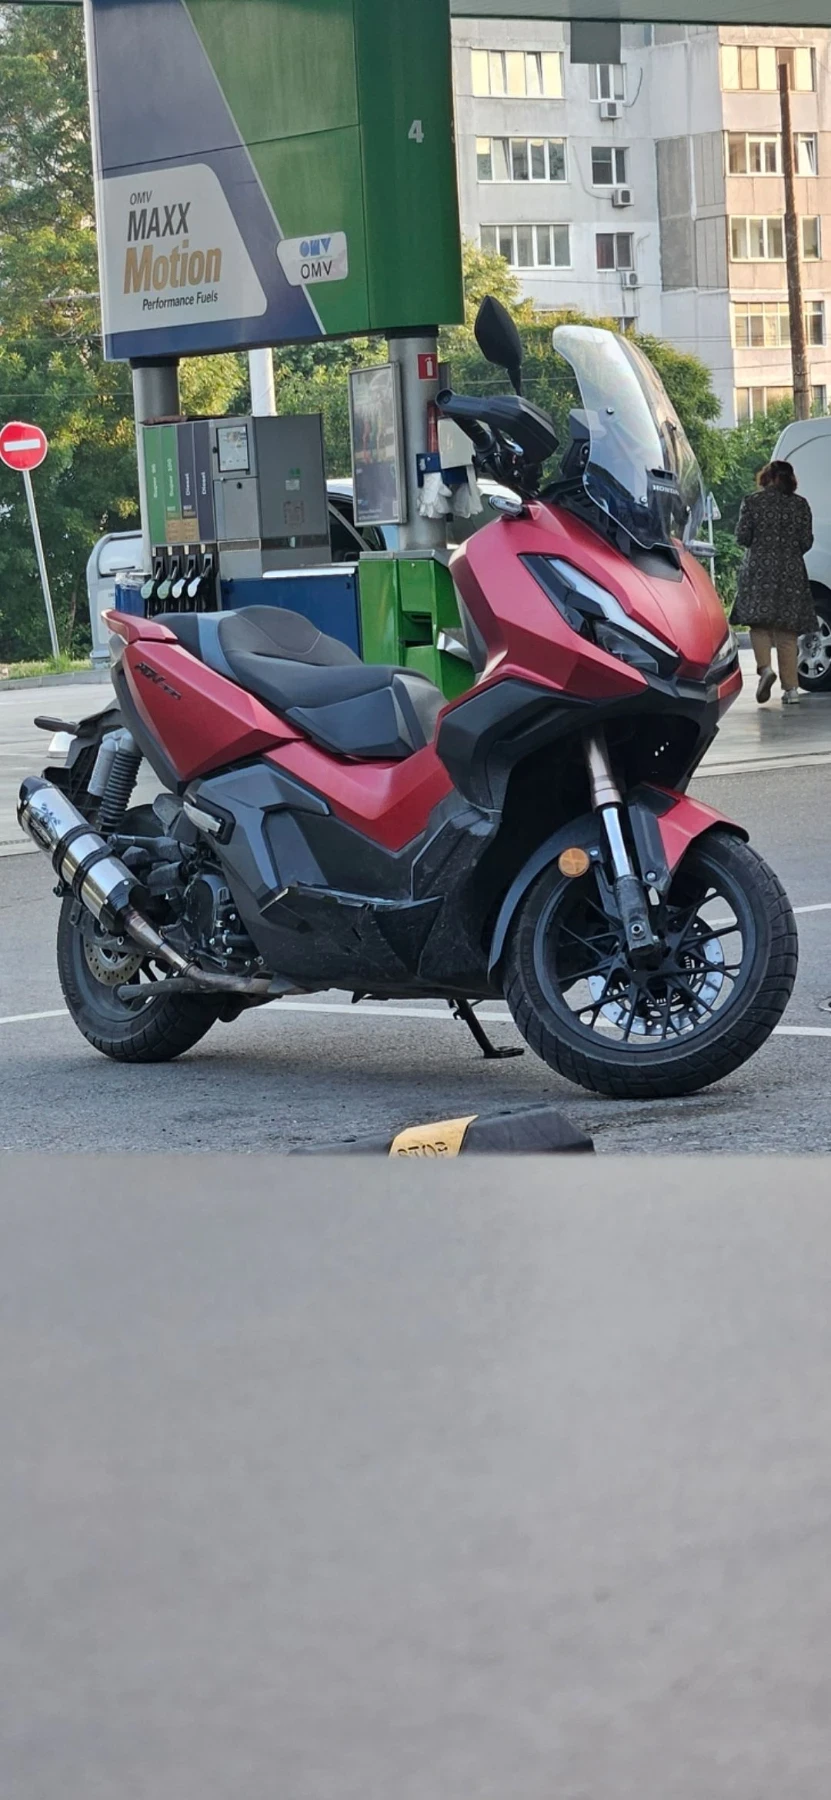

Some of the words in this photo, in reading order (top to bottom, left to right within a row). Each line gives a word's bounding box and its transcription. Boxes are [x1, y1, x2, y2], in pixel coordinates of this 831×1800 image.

[408, 120, 424, 143] 4
[130, 190, 153, 206] OMV
[127, 202, 191, 242] MAXX
[299, 237, 332, 257] OMV
[123, 239, 222, 295] Motion
[301, 261, 333, 280] OMV
[142, 296, 195, 312] Performance
[196, 290, 218, 306] Fuels
[653, 485, 679, 496] HONDA
